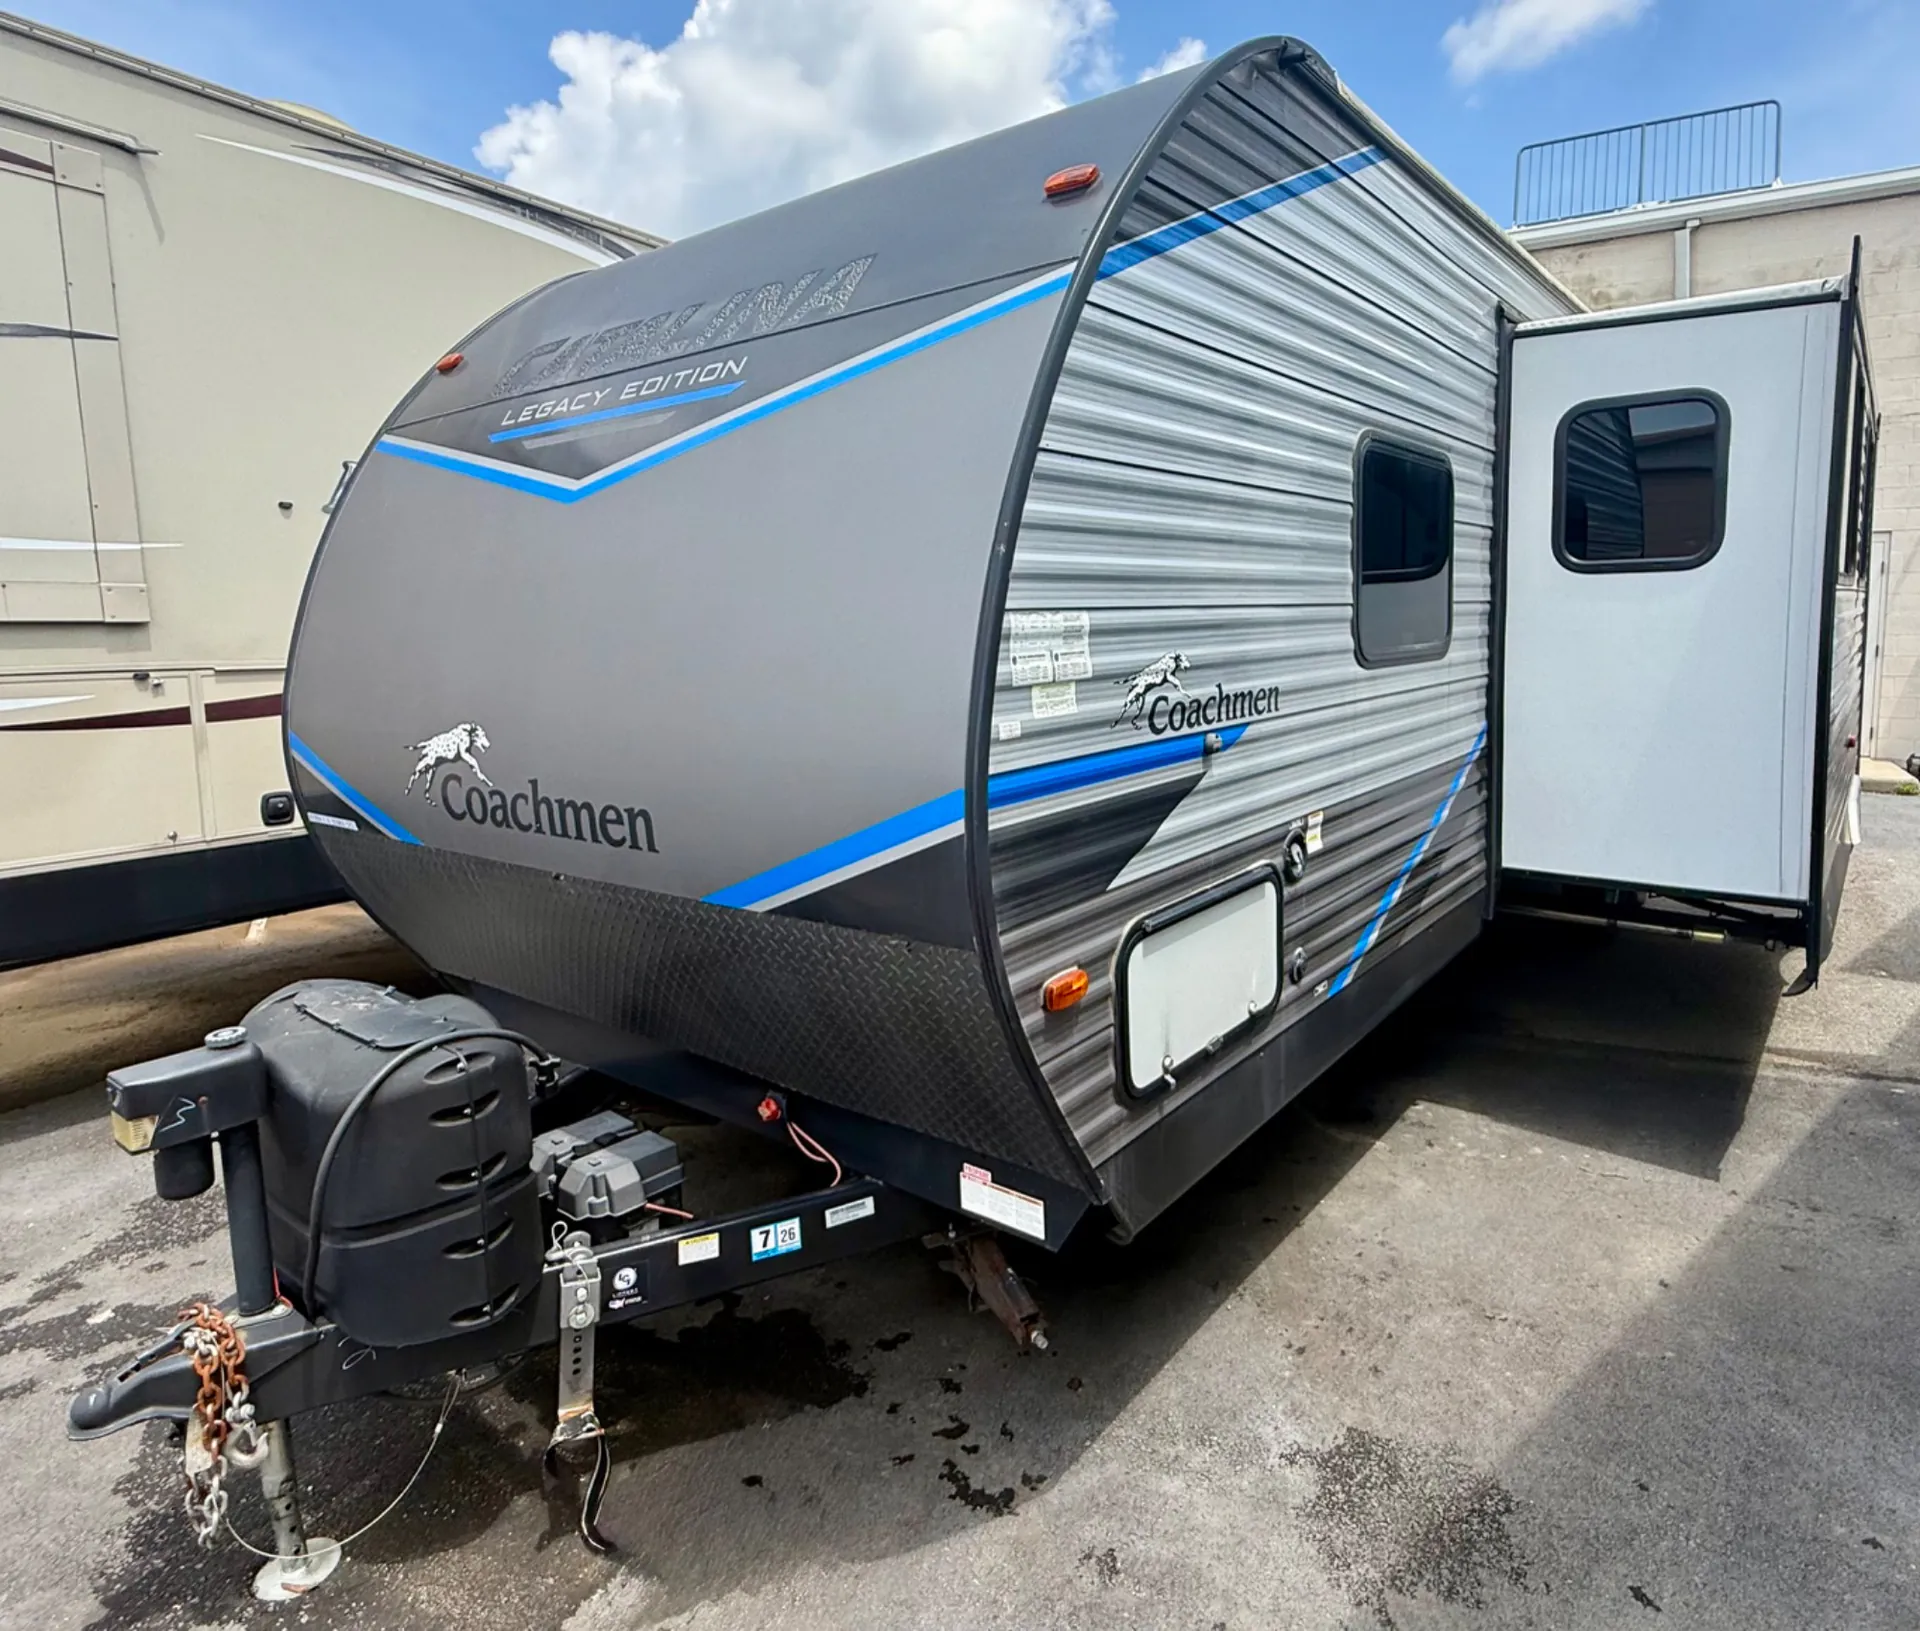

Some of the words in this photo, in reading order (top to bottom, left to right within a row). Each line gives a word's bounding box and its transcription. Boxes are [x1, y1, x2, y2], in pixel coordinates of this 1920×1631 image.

[501, 388, 611, 426] LEGACY
[620, 356, 748, 400] EDITION
[1149, 682, 1280, 735] Coachmen
[441, 772, 660, 853] Coachmen
[759, 1229, 771, 1248] 7
[780, 1227, 796, 1243] 26
